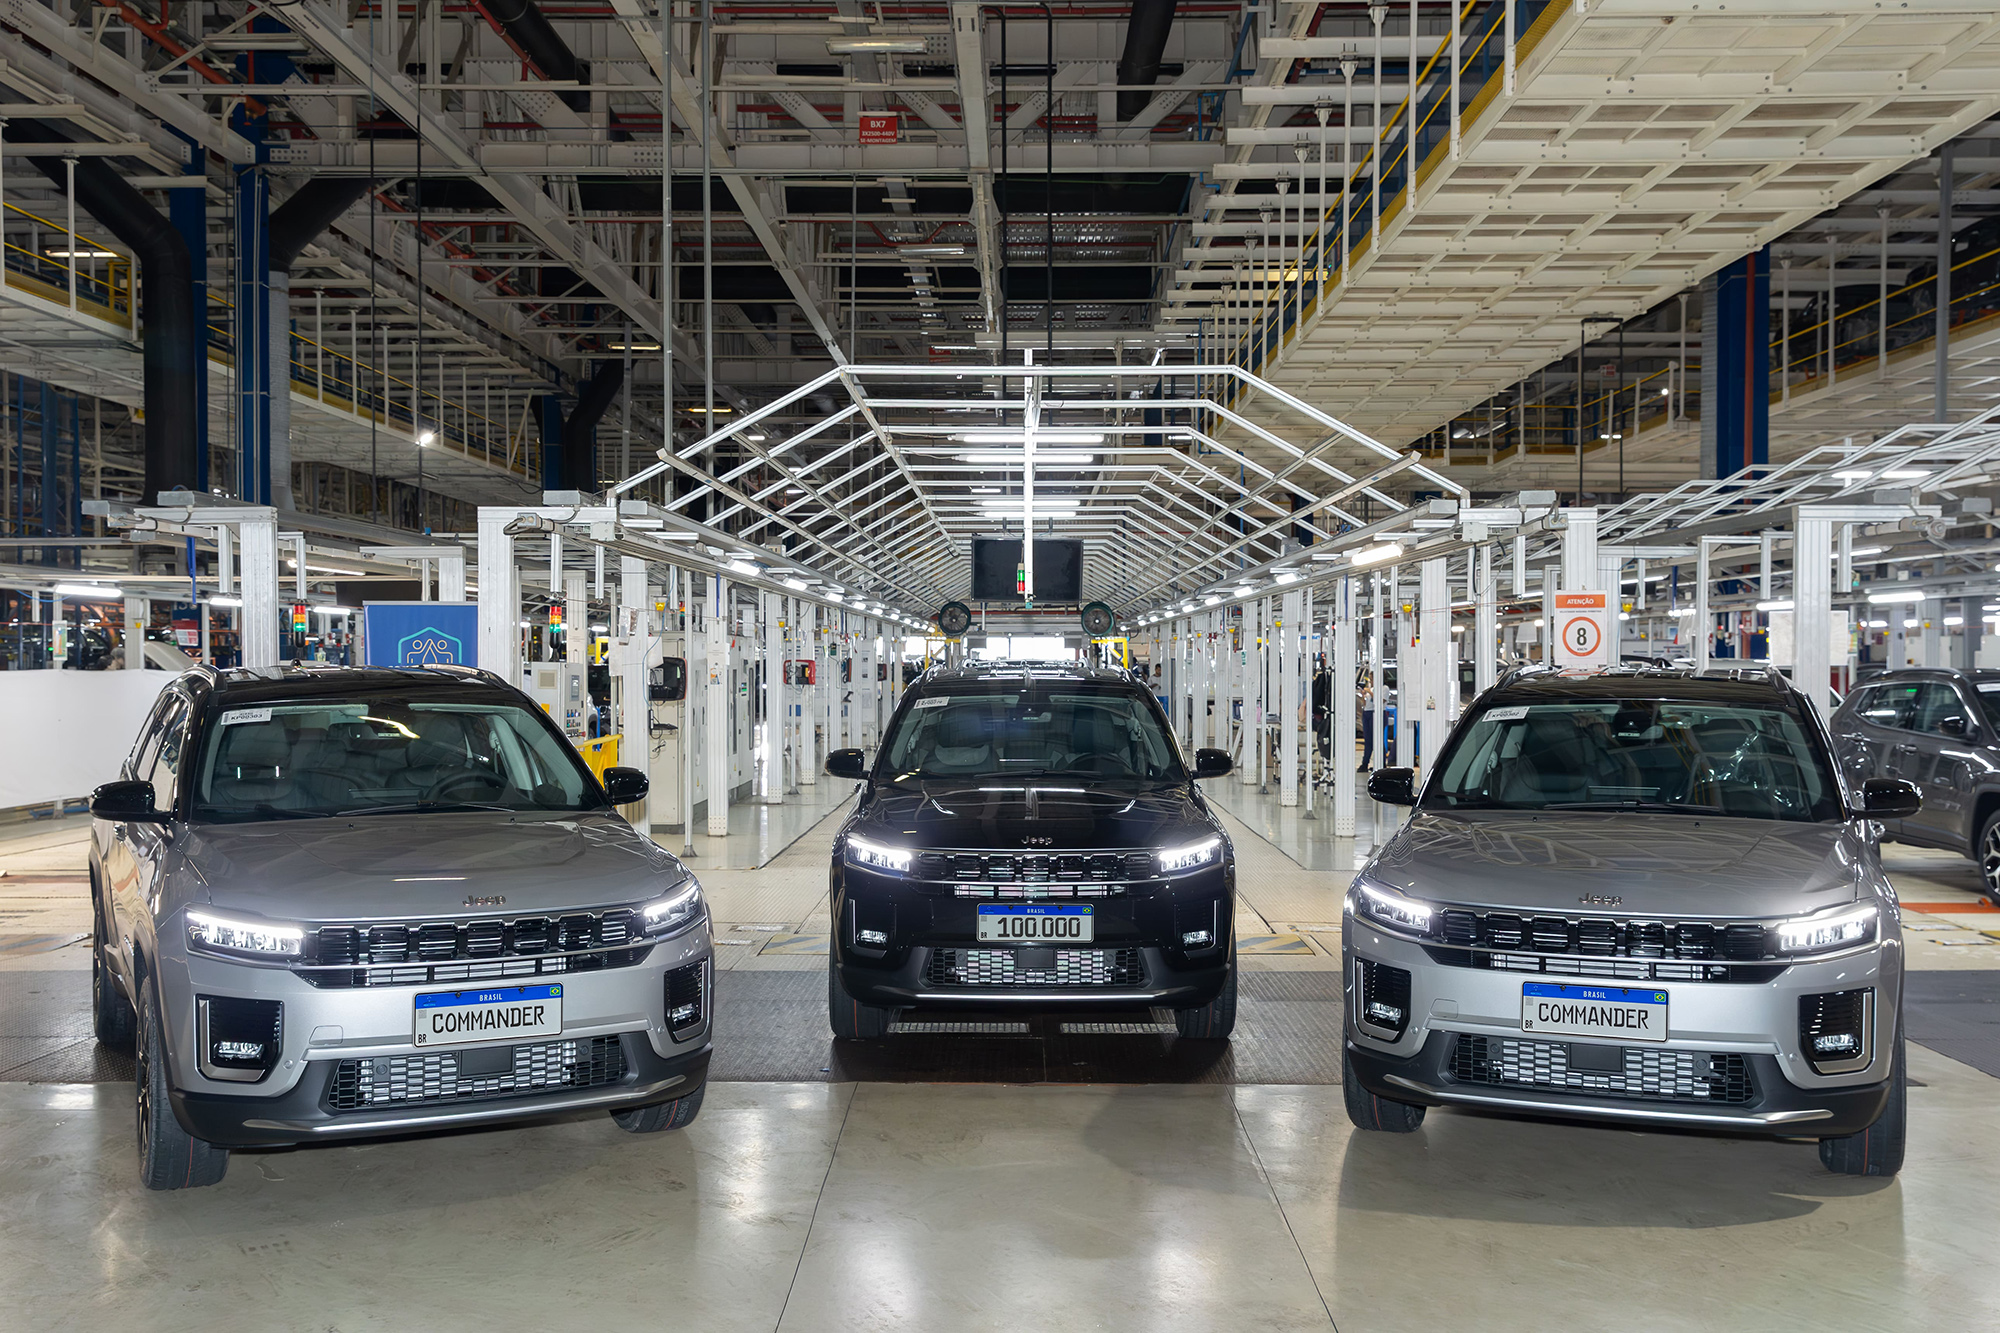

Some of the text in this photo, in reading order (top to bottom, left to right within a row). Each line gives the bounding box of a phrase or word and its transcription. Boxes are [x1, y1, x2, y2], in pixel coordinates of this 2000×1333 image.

[870, 120, 886, 128] BX7
[1576, 627, 1587, 646] 8
[1021, 835, 1053, 845] Jeep
[462, 895, 506, 906] Jeep
[1578, 893, 1623, 906] Jeep
[997, 917, 1081, 938] 100.000
[980, 931, 988, 939] BR
[479, 993, 503, 1002] BRASIL
[1583, 990, 1606, 999] BRASIL
[432, 1005, 545, 1034] COMMANDER
[1538, 1003, 1649, 1030] COMMANDER
[1525, 1020, 1534, 1029] BR
[418, 1034, 427, 1043] BR
